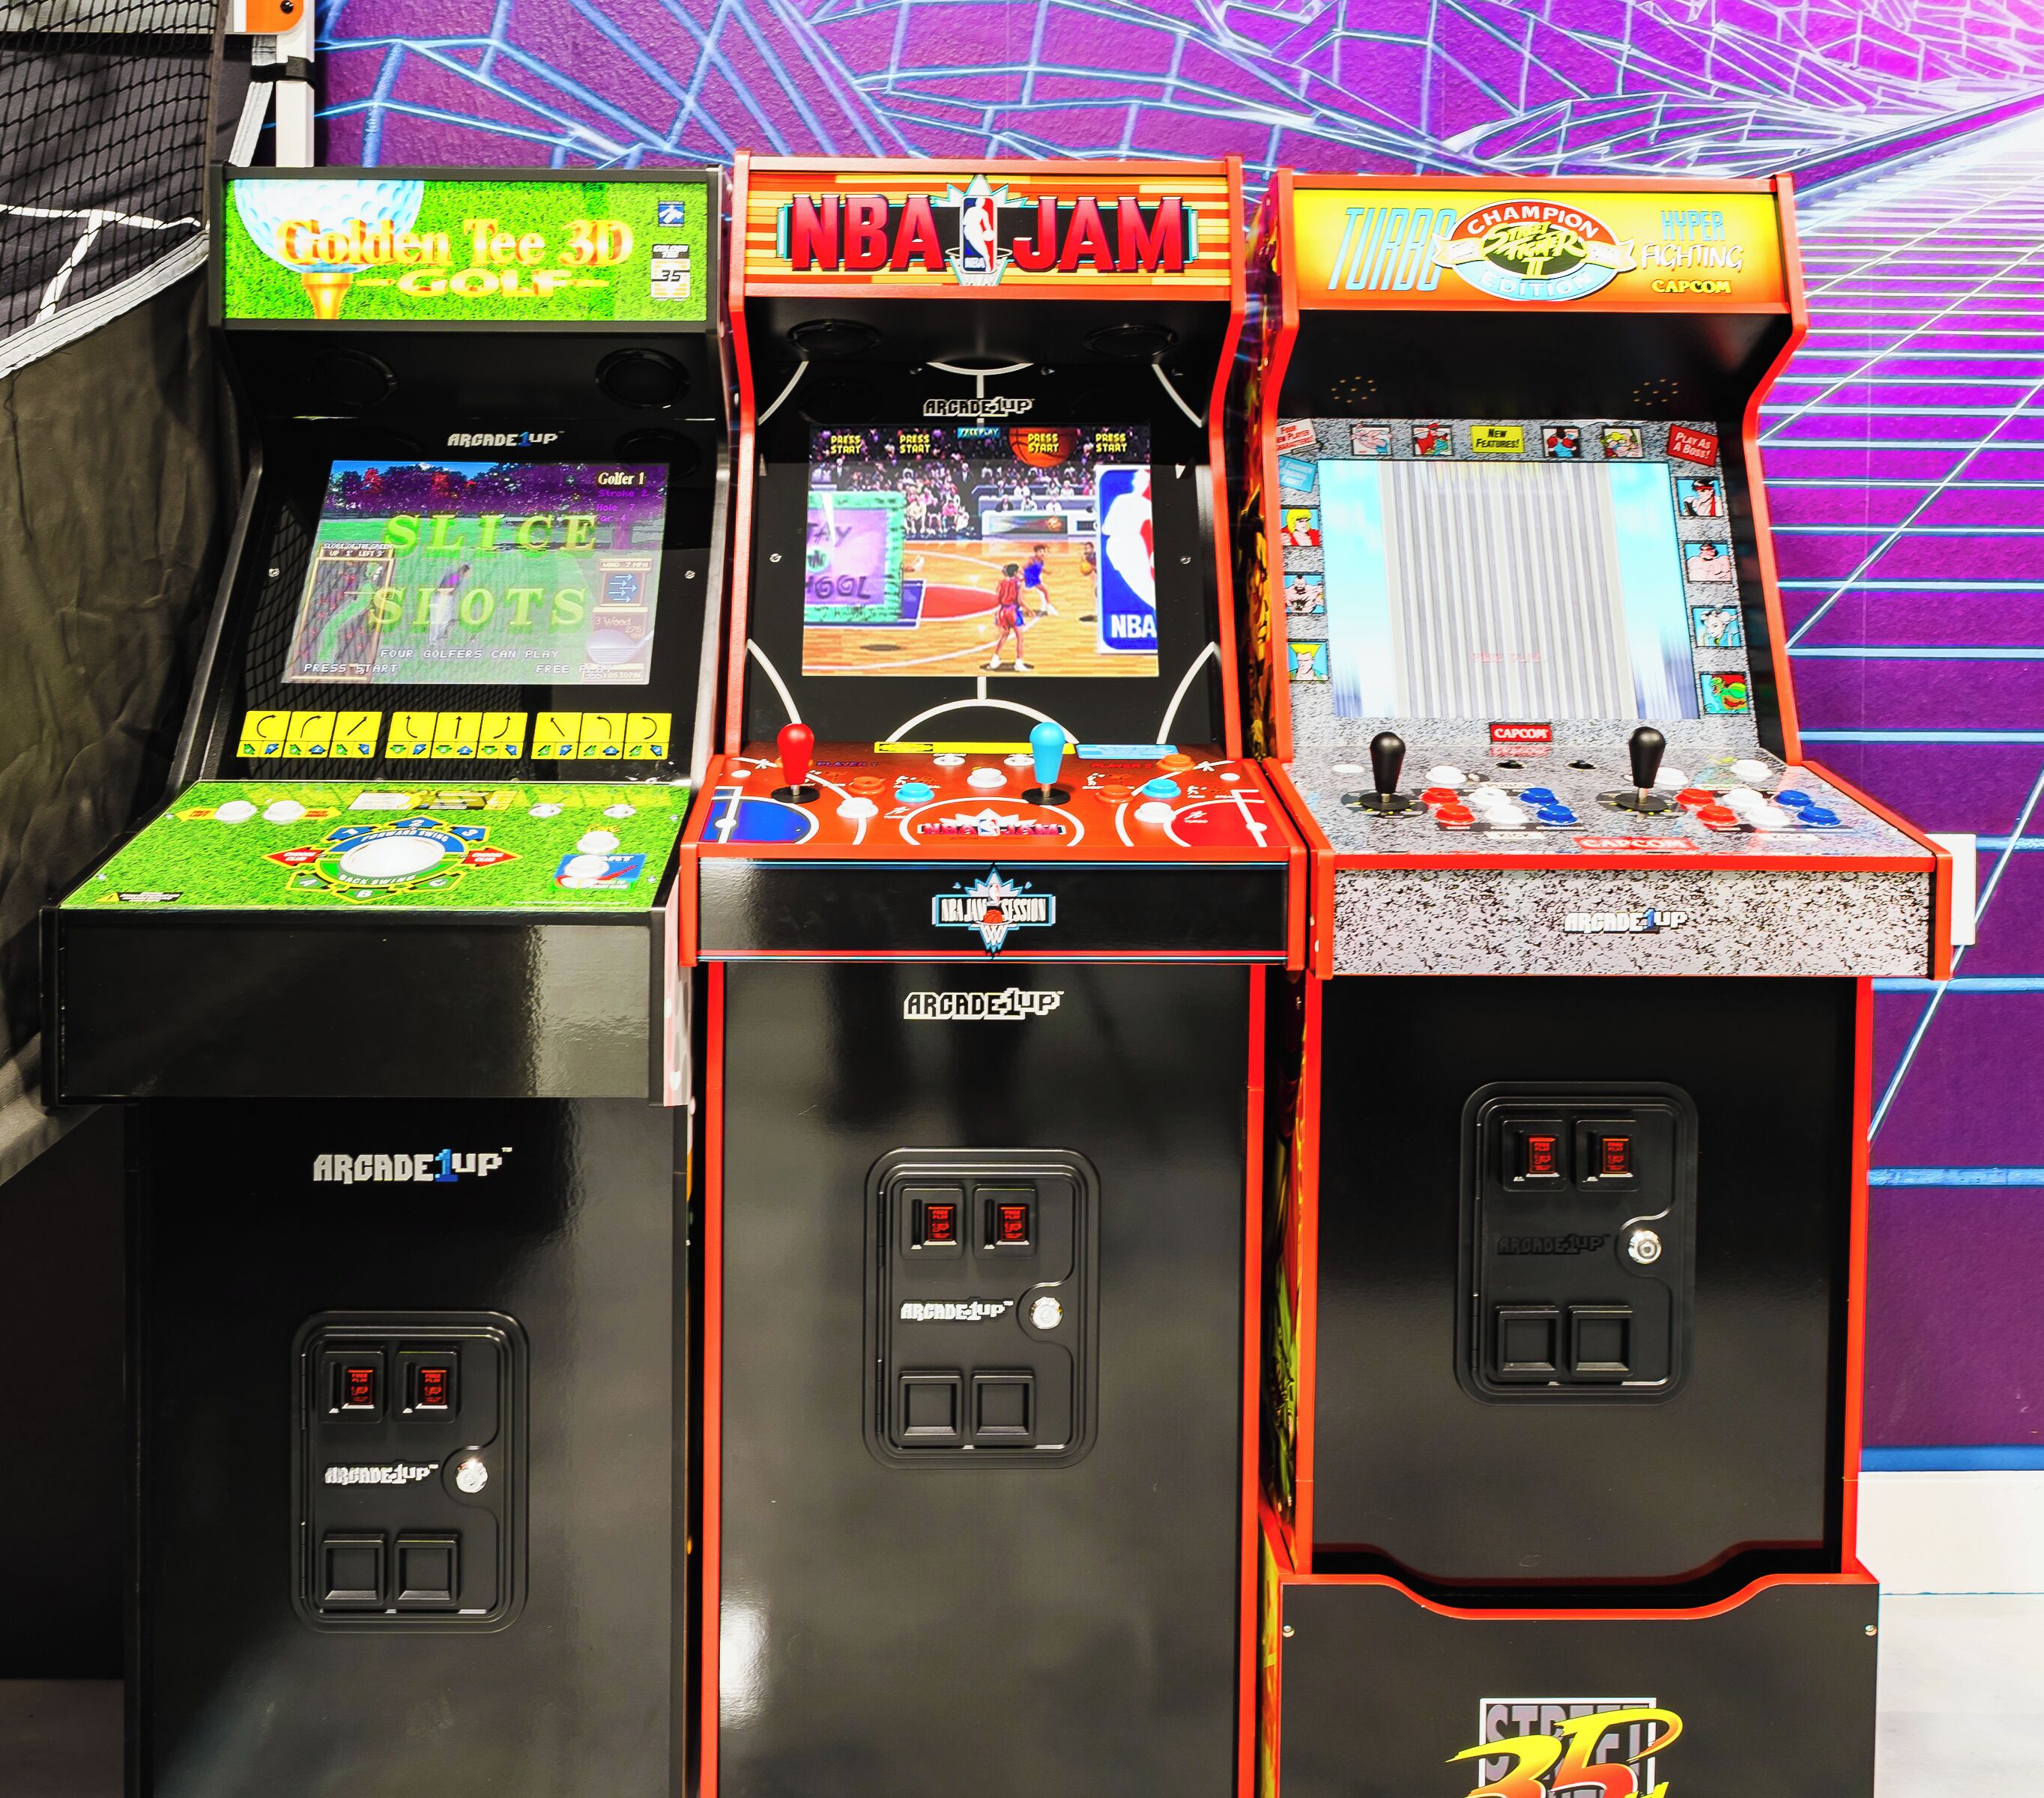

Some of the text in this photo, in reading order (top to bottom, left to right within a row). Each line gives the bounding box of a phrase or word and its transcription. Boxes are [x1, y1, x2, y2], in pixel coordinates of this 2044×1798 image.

[1467, 205, 1600, 239] CHAMPION
[1661, 211, 1725, 241] HYPER
[792, 193, 1186, 273] NBA JAM
[276, 219, 634, 267] Golden Tee 3D
[1328, 208, 1457, 291] TURBO
[1641, 243, 1744, 272] FIGHTING
[661, 270, 683, 282] 35
[398, 268, 574, 297] GOLF
[1481, 270, 1594, 297] EDITION
[1651, 279, 1732, 294] CAPCOM
[1028, 433, 1059, 443] PRESS
[1095, 433, 1126, 443] PRESS
[1487, 428, 1508, 438] NEW
[830, 435, 861, 444] PRESS
[899, 435, 930, 444] PRESS
[1675, 432, 1713, 450] PLAY AS
[830, 444, 862, 454] START
[899, 444, 931, 454] START
[1028, 443, 1059, 453] START
[1095, 443, 1127, 453] START
[1673, 444, 1681, 452] A
[598, 471, 645, 485] Golfer 1
[383, 514, 597, 553] SLICE
[806, 522, 853, 548] TAY
[805, 575, 871, 600] HOOL
[1111, 614, 1158, 638] NBA
[380, 649, 560, 659] FOUR GOLFERS CAN PLAY
[303, 663, 399, 674] PRESS START
[536, 665, 570, 674] FREE
[1494, 728, 1549, 739] CAPCOM
[924, 822, 1060, 835] NBA JAM
[1580, 838, 1691, 848] CAPCOM
